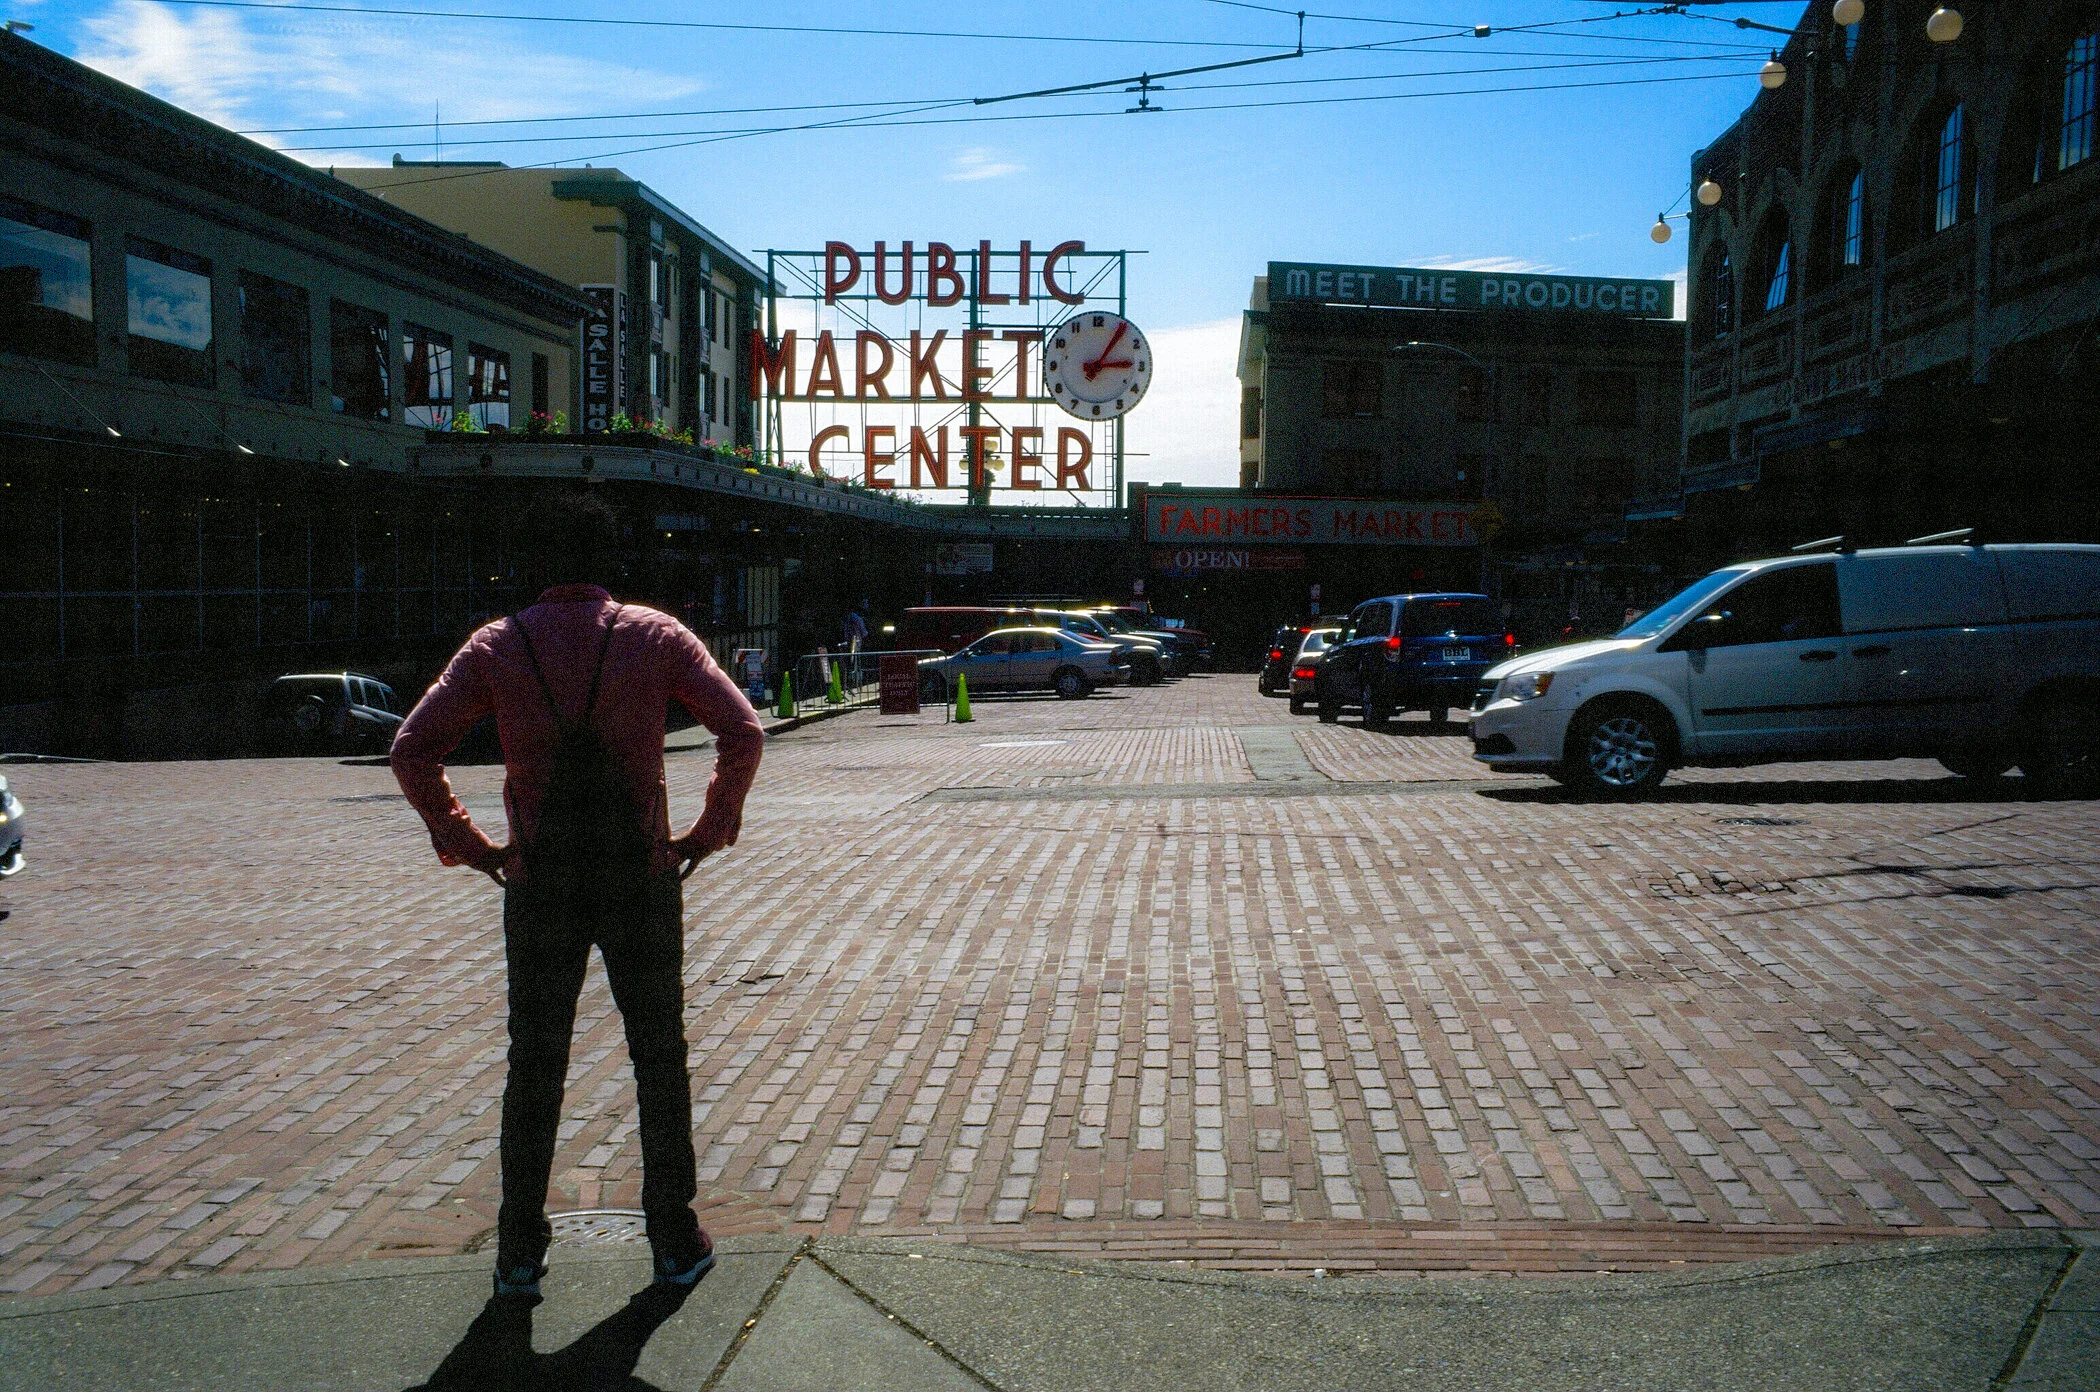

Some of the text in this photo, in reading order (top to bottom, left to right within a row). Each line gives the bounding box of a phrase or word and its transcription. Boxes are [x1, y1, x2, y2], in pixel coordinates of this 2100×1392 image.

[824, 240, 1086, 307] PUBLIC
[1285, 268, 1662, 313] MEET THE PRODUCER
[1093, 316, 1104, 327] 12
[1071, 322, 1080, 333] 11
[1055, 339, 1065, 349] 10
[1133, 339, 1140, 349] 2
[587, 323, 609, 394] SALLE
[749, 330, 1045, 400] MARKET
[1050, 360, 1057, 371] 9
[1138, 361, 1146, 372] 3
[1055, 383, 1063, 394] 8
[1130, 383, 1140, 394] 4
[1071, 400, 1078, 410] 7
[1092, 405, 1100, 415] 6
[1116, 400, 1123, 410] 5
[587, 403, 608, 434] HO
[809, 426, 1093, 490] CENTER
[1160, 505, 1469, 539] FARMERS MARKET
[1175, 550, 1251, 569] OPEN!
